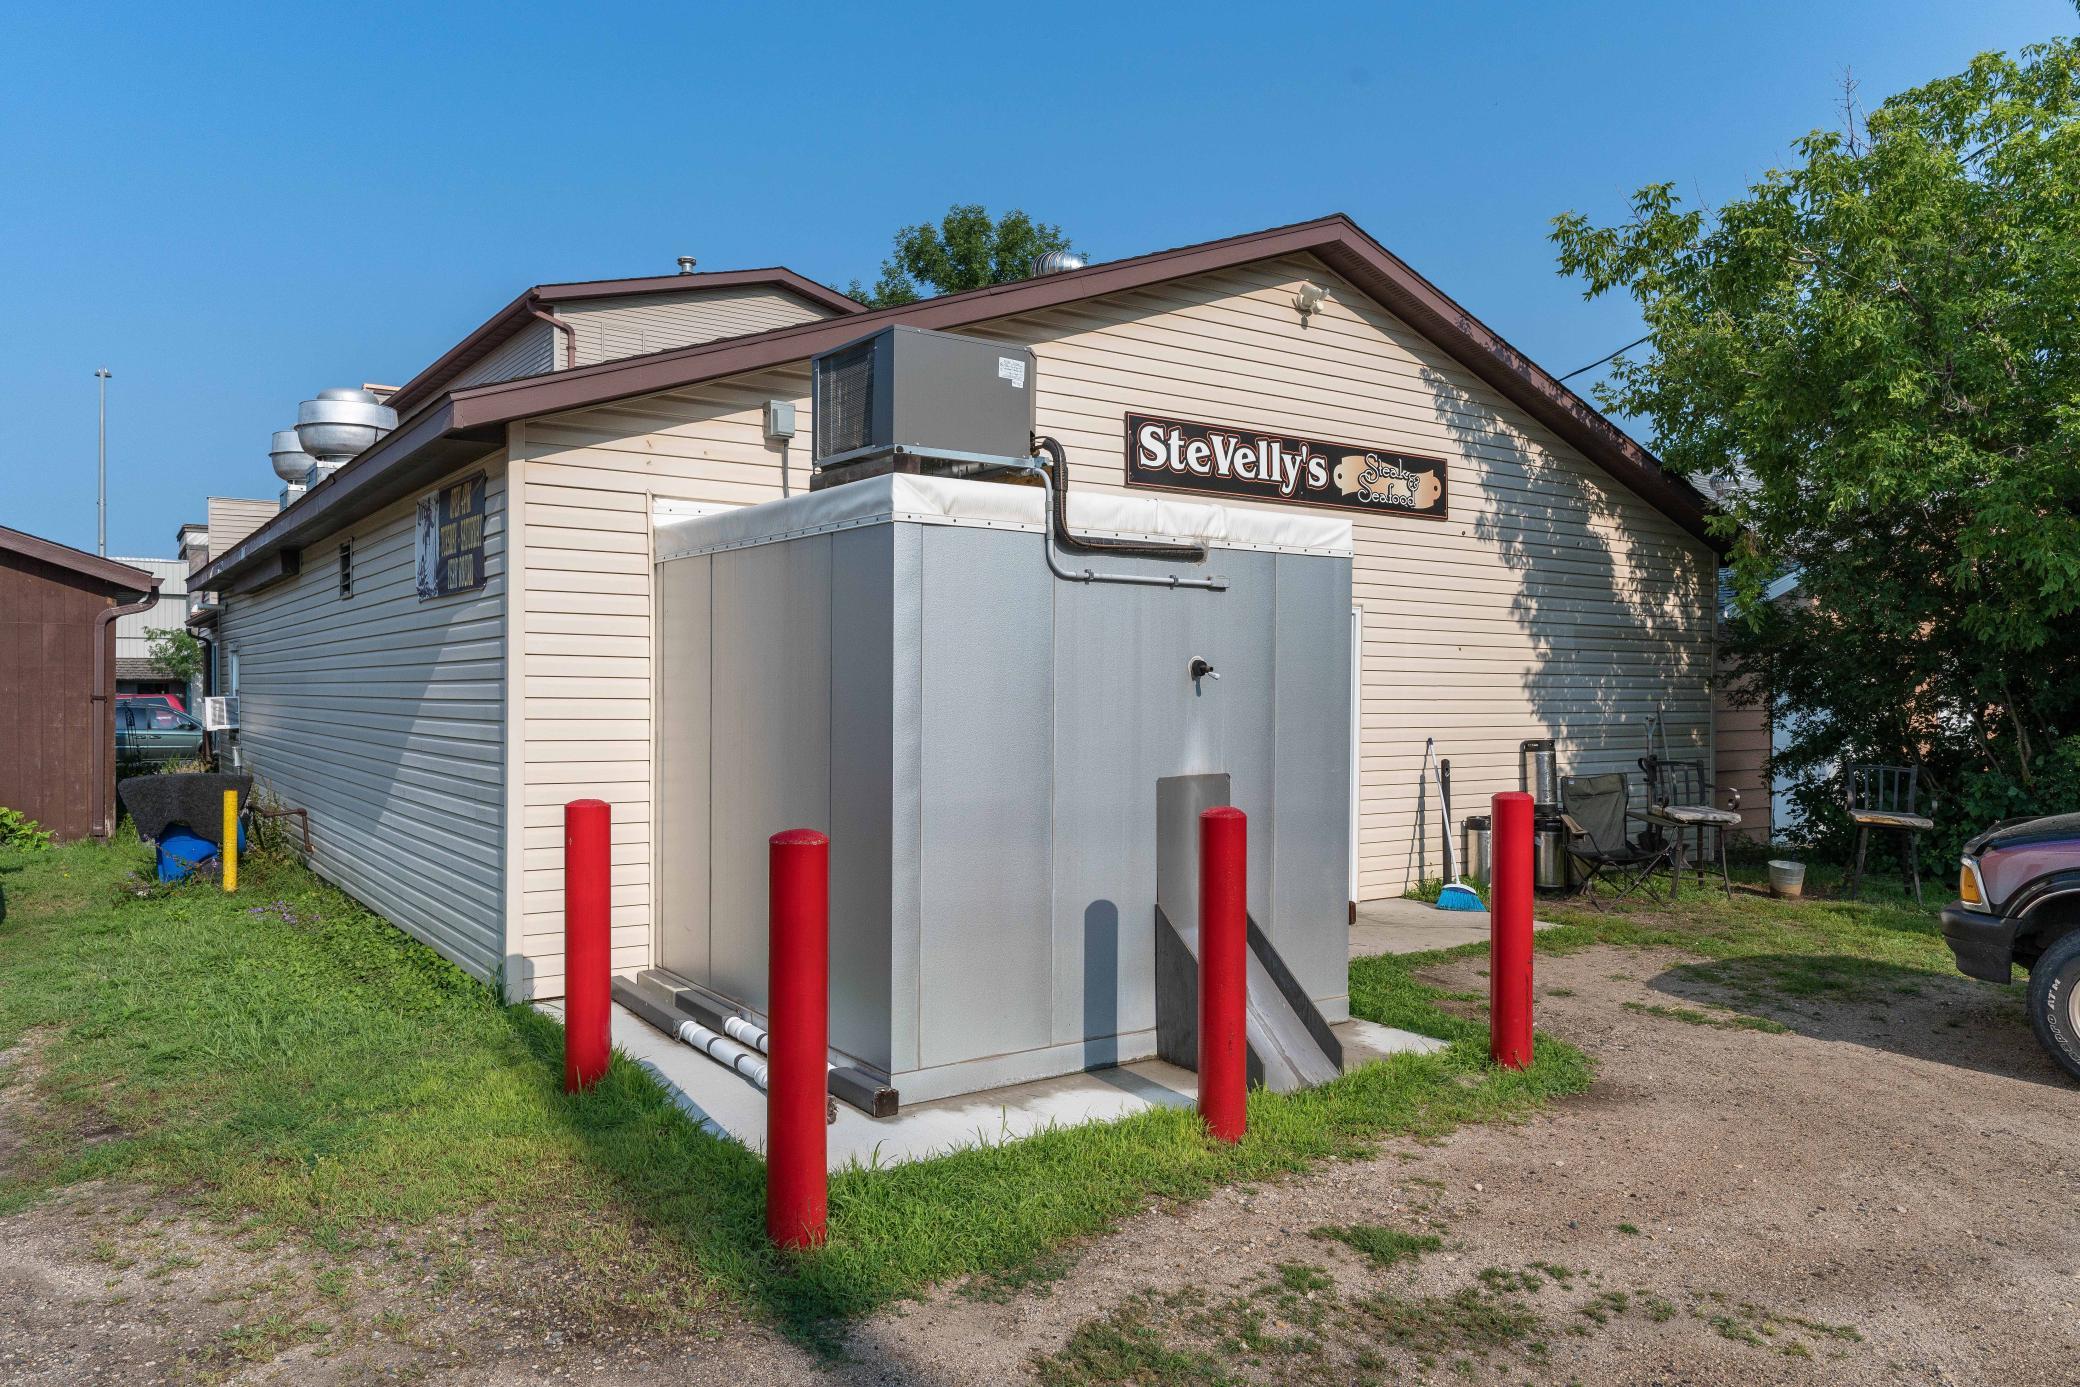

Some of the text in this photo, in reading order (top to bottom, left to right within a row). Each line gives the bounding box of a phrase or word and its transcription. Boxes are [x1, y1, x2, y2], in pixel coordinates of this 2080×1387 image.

[1138, 424, 1328, 495] SteVelly's
[1364, 453, 1420, 491] Steak &
[1357, 473, 1416, 506] Seafood
